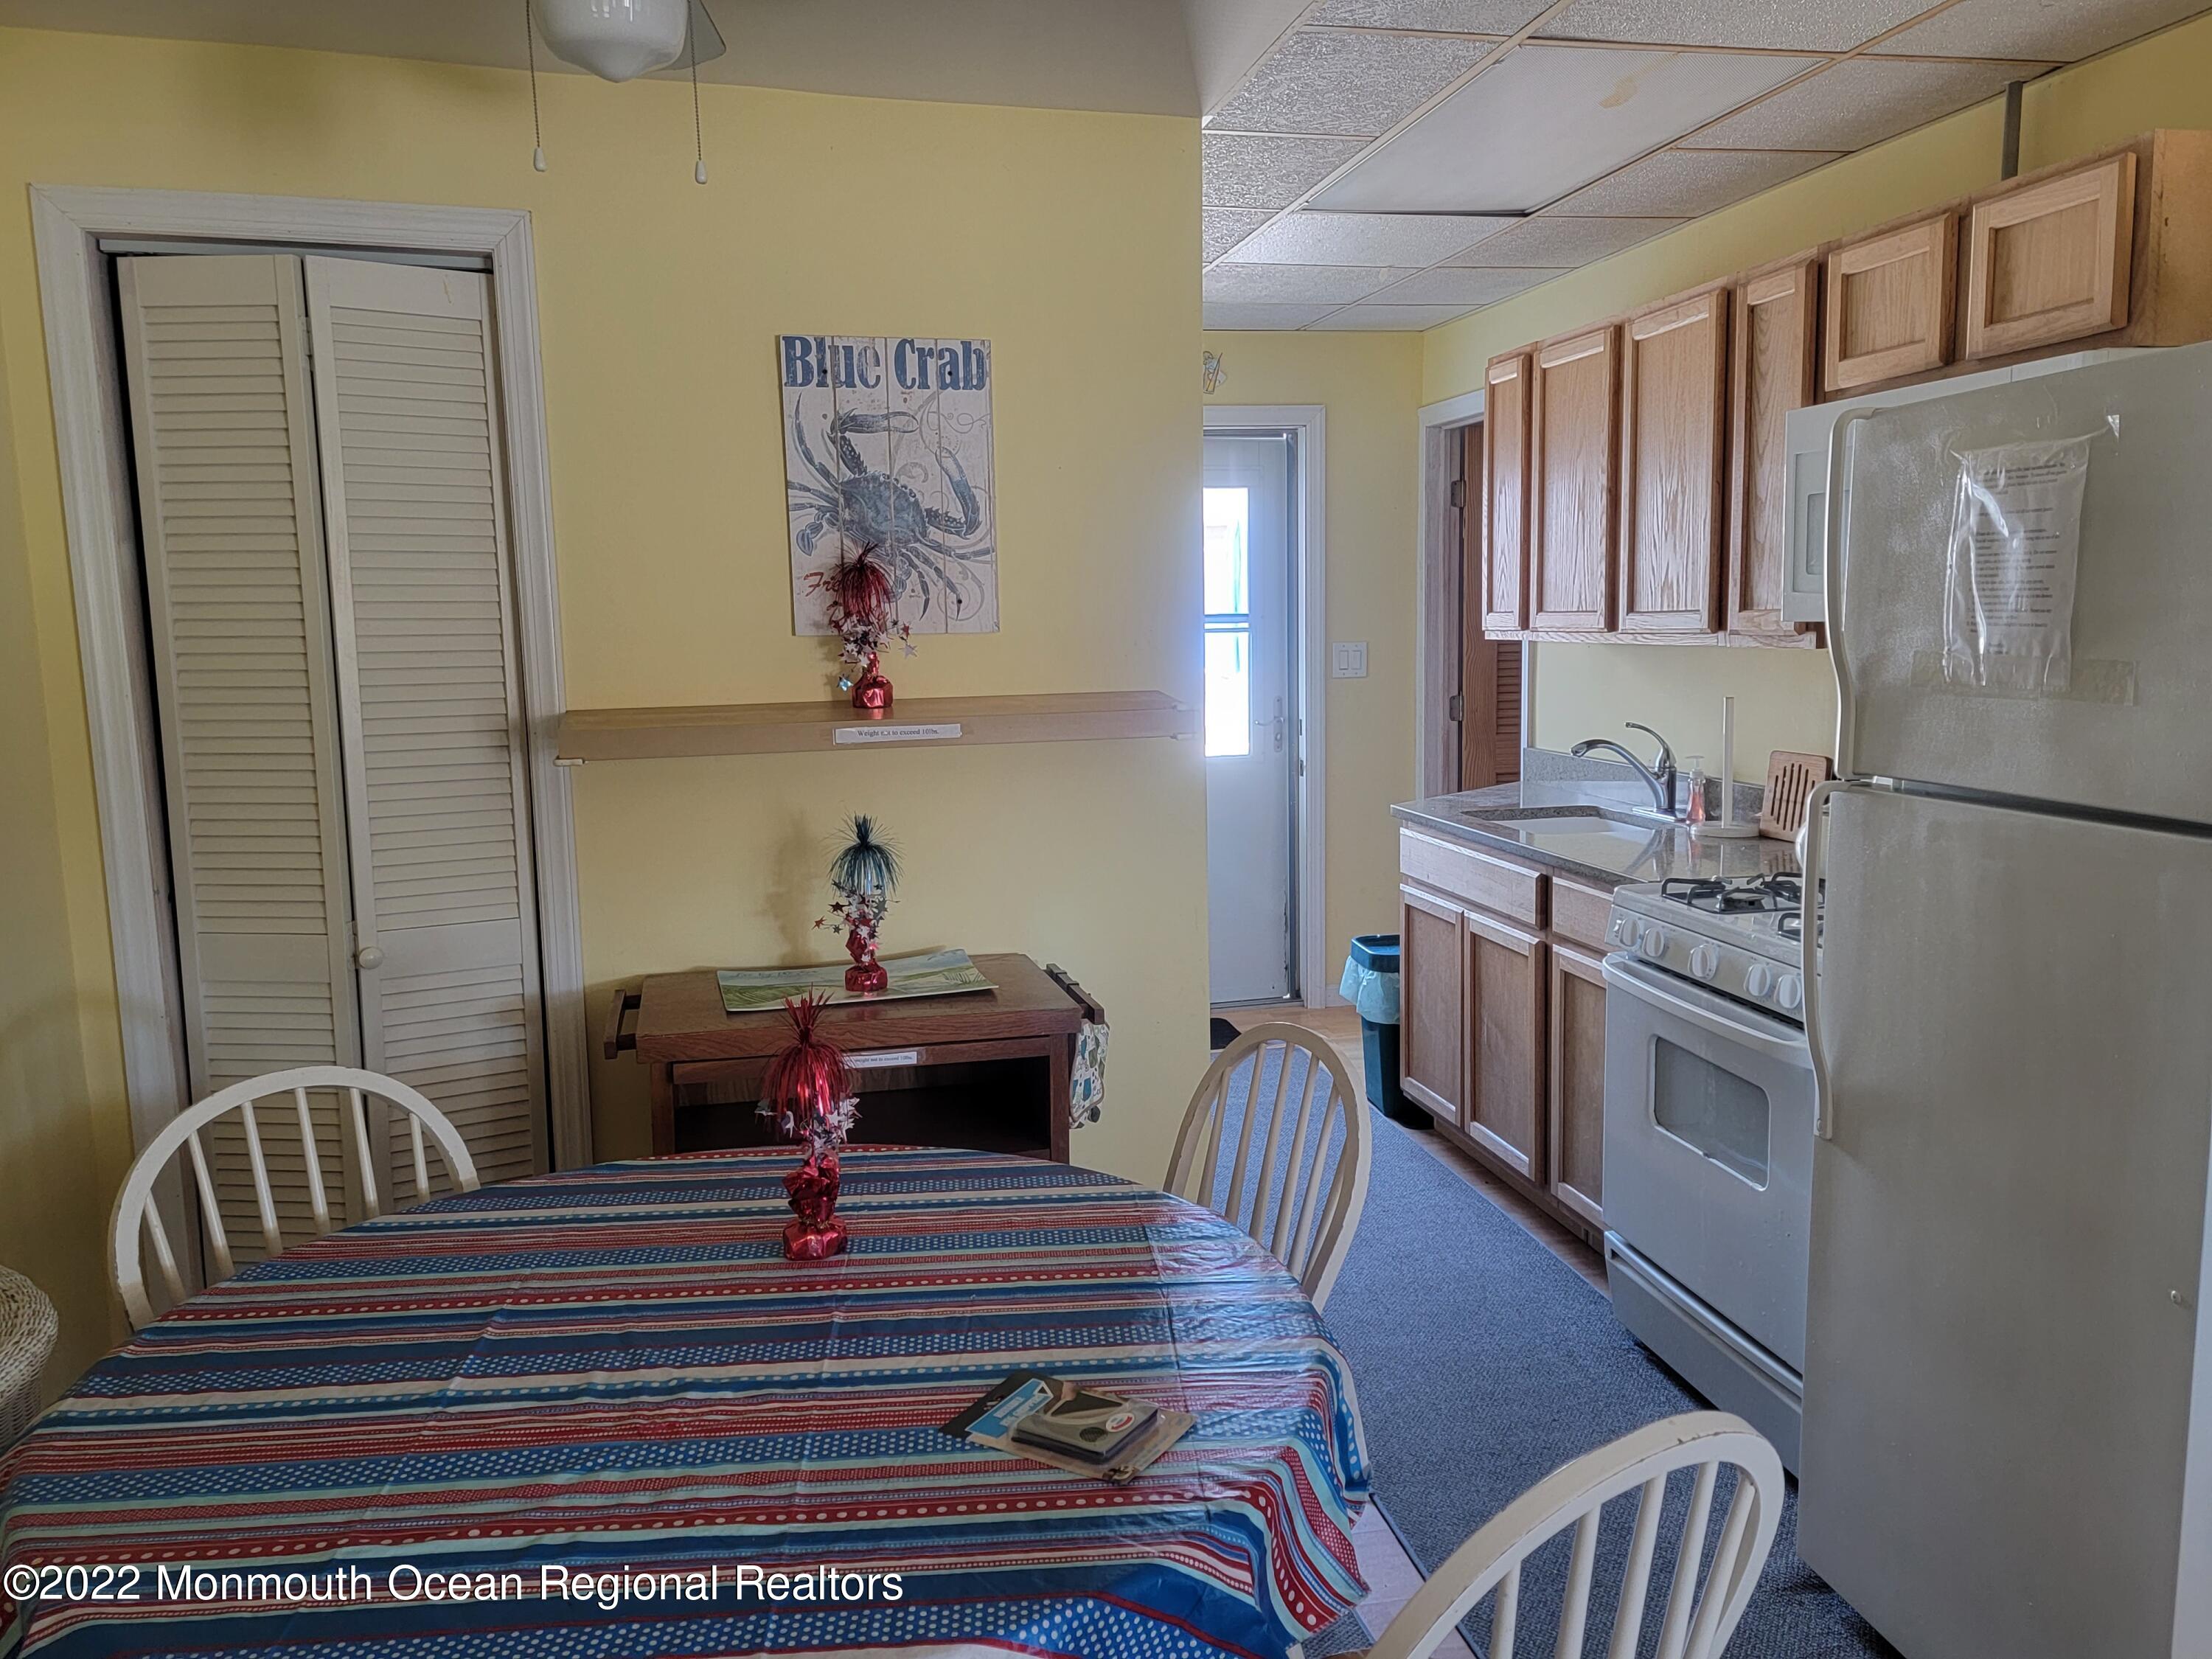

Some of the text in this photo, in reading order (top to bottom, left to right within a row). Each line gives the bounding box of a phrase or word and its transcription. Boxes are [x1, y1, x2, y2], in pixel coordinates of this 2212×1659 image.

[782, 336, 987, 391] Blue Crab
[858, 729, 879, 737] Weight
